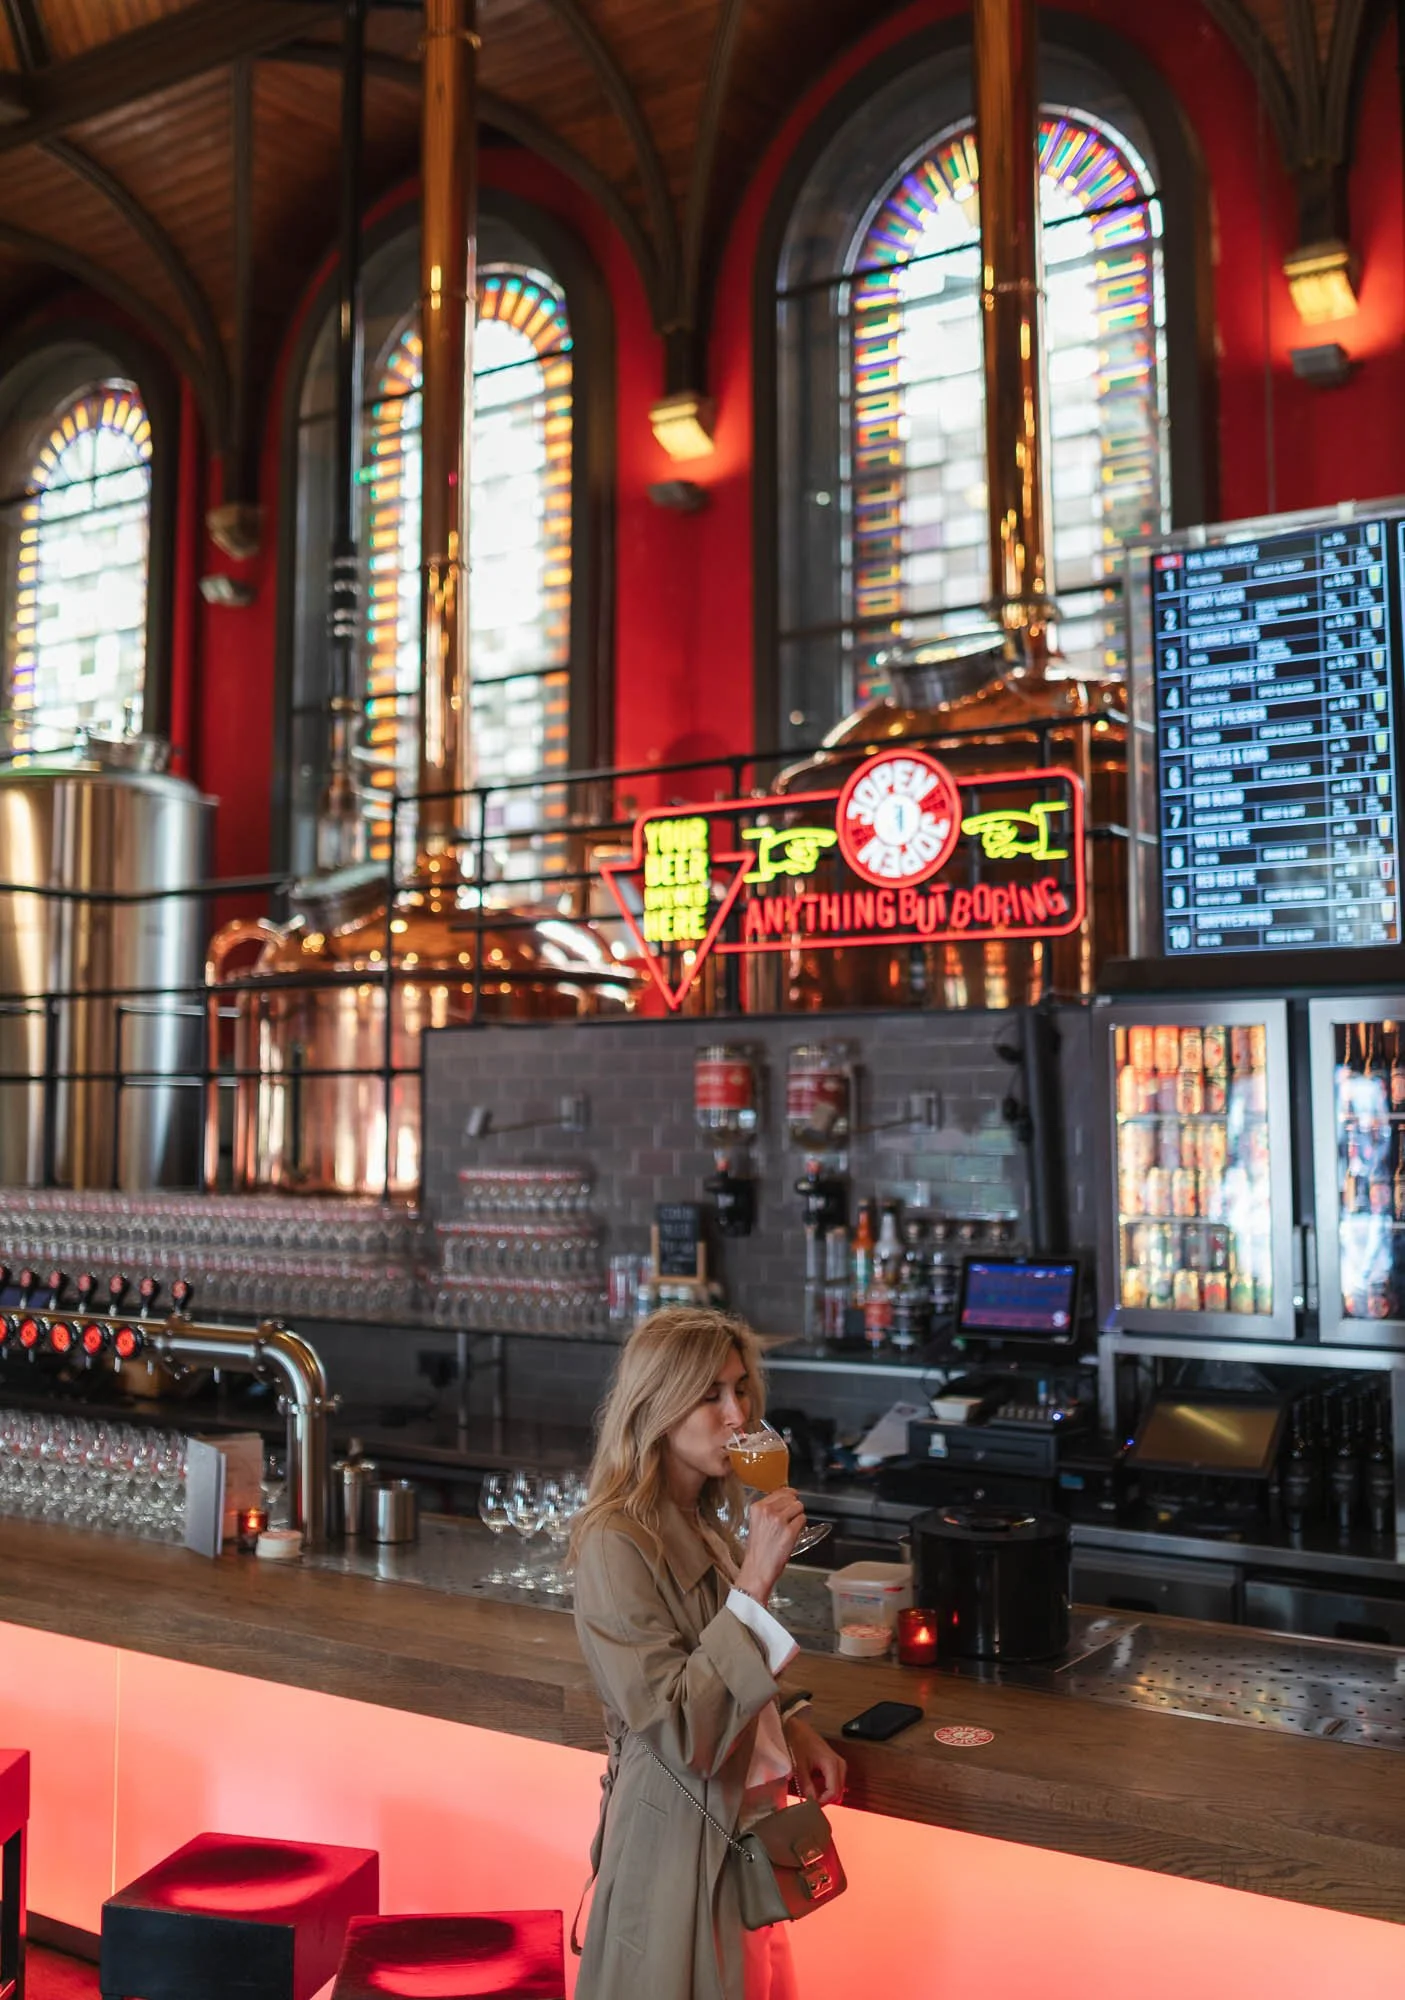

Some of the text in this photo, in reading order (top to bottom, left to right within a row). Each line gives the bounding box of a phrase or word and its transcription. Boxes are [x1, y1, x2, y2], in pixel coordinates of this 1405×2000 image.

[1163, 570, 1175, 591] 1
[1164, 609, 1178, 631] 2
[1164, 648, 1179, 670] 3
[1231, 666, 1256, 685] PALE
[1256, 663, 1276, 682] ALE
[1166, 687, 1180, 710] 4
[1167, 726, 1181, 749] 5
[1168, 765, 1182, 789] 6
[846, 758, 939, 826] JOPEN
[1169, 805, 1184, 829] 7
[856, 811, 951, 879] JOPEN
[1171, 845, 1185, 869] 8
[645, 849, 710, 887] BEER
[747, 890, 897, 936] ANYTHING
[899, 884, 949, 935] BUT
[951, 876, 1068, 929] BORING
[1172, 885, 1186, 909] 9
[643, 907, 708, 942] HERE
[1169, 925, 1190, 949] 10
